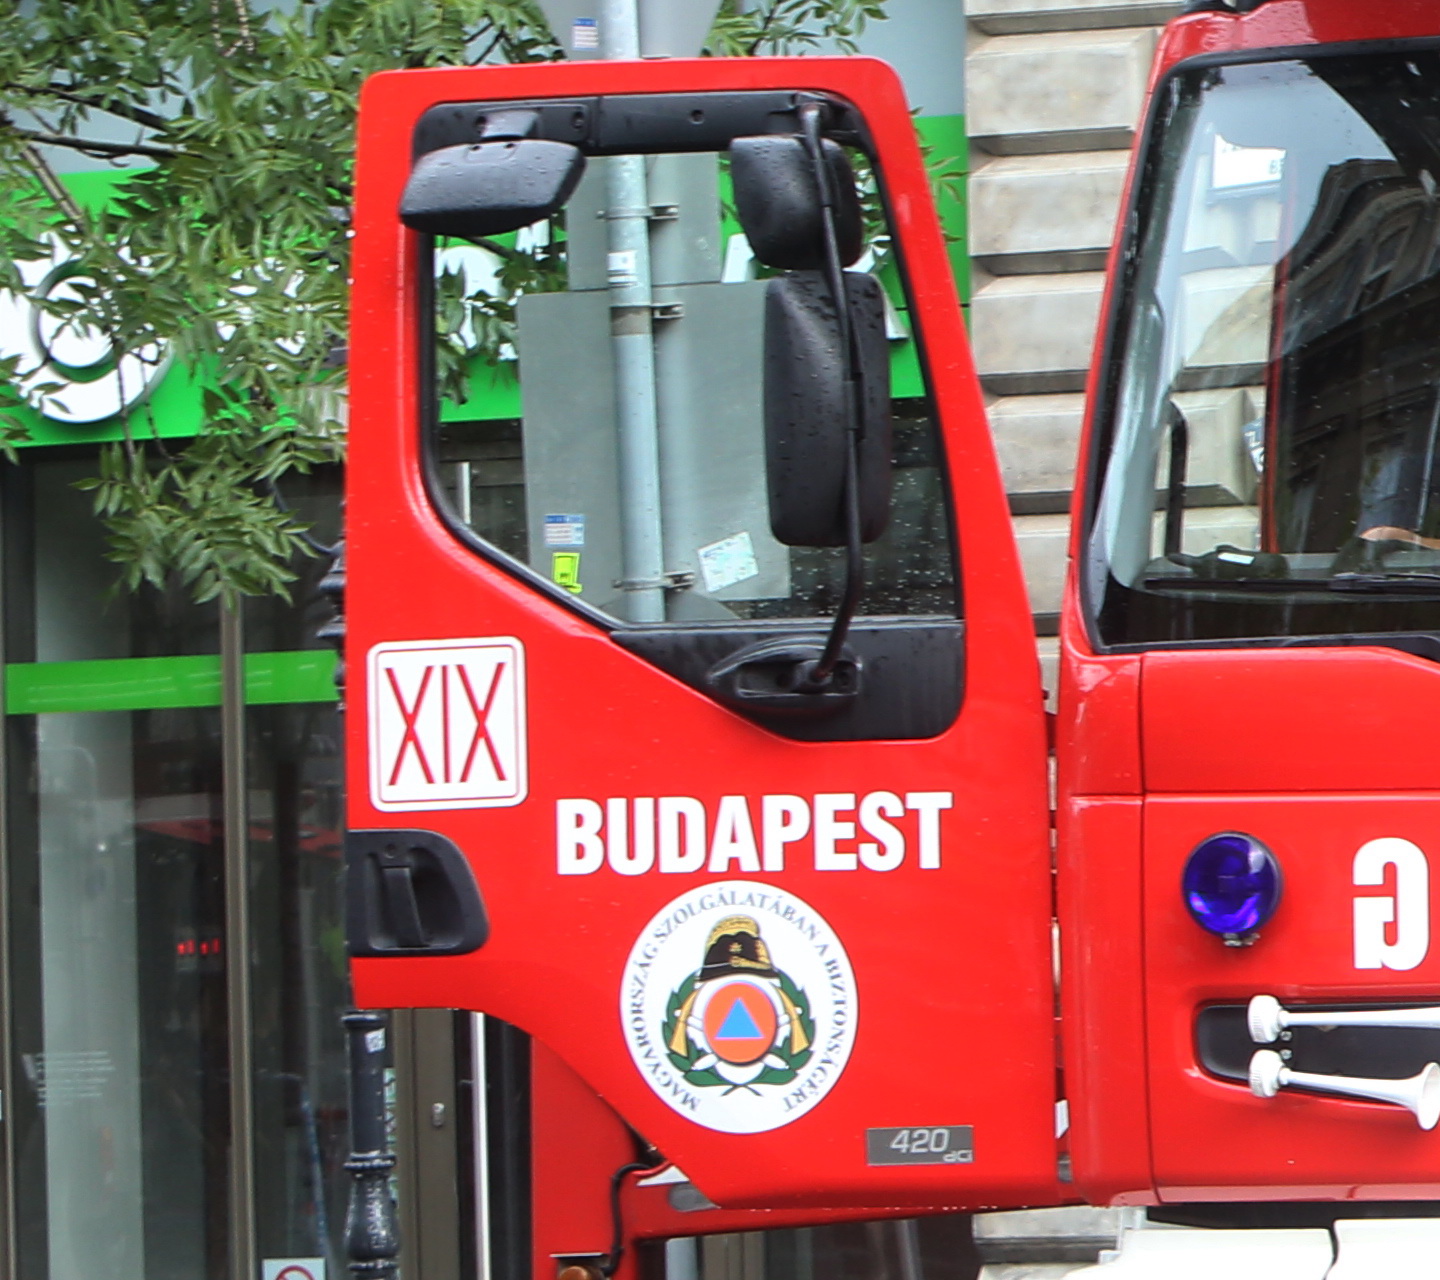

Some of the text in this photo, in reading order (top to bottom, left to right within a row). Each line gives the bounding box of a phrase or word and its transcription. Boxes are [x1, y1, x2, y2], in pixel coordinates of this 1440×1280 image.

[385, 661, 508, 787] XIX
[555, 791, 953, 876] BUDAPEST
[629, 886, 849, 1114] MAGYARORSZÁG SZOLGÁLATÁBAN A BIZTONSÁGÉRT
[889, 1128, 951, 1154] 420
